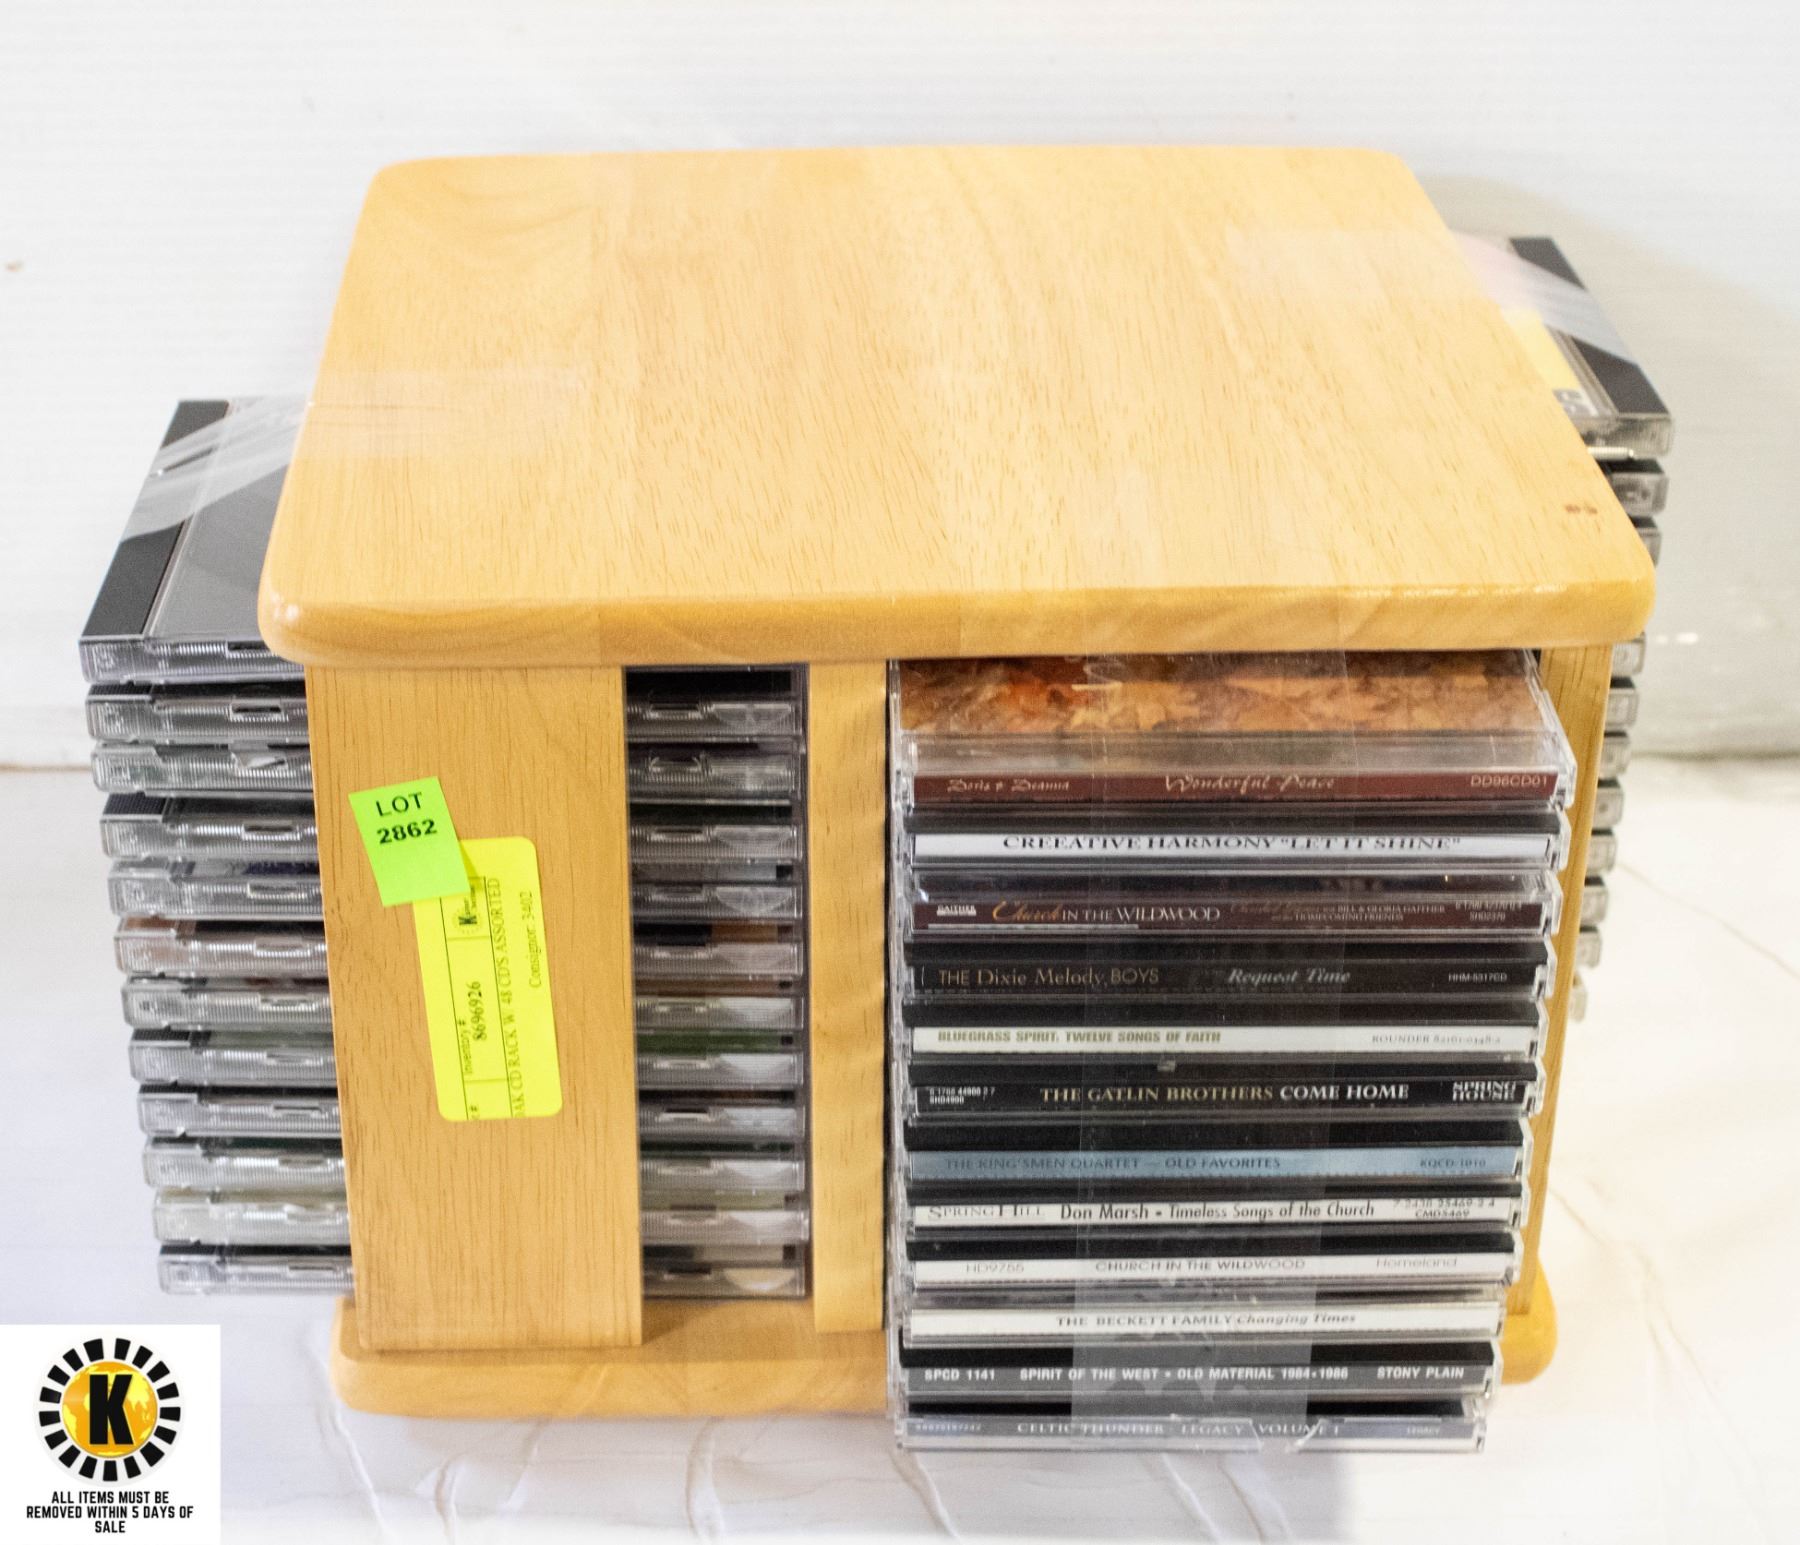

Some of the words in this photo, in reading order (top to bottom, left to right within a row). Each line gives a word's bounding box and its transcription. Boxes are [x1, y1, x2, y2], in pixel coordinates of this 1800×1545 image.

[1165, 774, 1270, 795] Wonderful
[1277, 774, 1335, 792] Peace
[375, 791, 423, 818] LOT
[376, 818, 439, 845] 2862
[1148, 836, 1275, 849] HARMONY
[1281, 835, 1341, 849] "LET
[1344, 836, 1363, 849] IT
[1374, 835, 1461, 849] SHINE"
[487, 878, 508, 955] ASSORTED
[1062, 905, 1075, 922] IN
[1083, 905, 1112, 922] THE
[1116, 905, 1221, 922] WILDWOOD
[938, 969, 970, 985] THE
[976, 968, 1027, 986] Dixie
[1034, 967, 1102, 988] Melody
[1110, 968, 1159, 985] BOYS
[1228, 968, 1298, 987] Request
[1305, 967, 1351, 982] Time
[467, 980, 488, 1042] 8696926
[937, 1030, 1011, 1043] BLUEGRASS
[1065, 1031, 1113, 1043] TWELVE
[1117, 1031, 1161, 1043] SONGS
[1165, 1031, 1181, 1043] OF
[1185, 1031, 1221, 1043] FAITH
[462, 1023, 473, 1076] Inventory
[505, 1028, 520, 1070] RACK
[509, 1070, 523, 1091] CD
[1453, 1081, 1517, 1091] SPRING
[1040, 1087, 1081, 1103] THE
[1087, 1087, 1160, 1102] GATLIN
[1166, 1085, 1274, 1102] BROTHERS
[1280, 1085, 1340, 1101] COME
[1346, 1084, 1409, 1100] HOME
[945, 1158, 972, 1169] THE
[1070, 1157, 1139, 1170] QUARTET
[1164, 1157, 1196, 1169] OLD
[1201, 1157, 1281, 1169] FAVORITES
[1060, 1206, 1092, 1220] Don
[1099, 1204, 1149, 1220] Marsh
[1169, 1203, 1228, 1219] Timeless
[1233, 1202, 1274, 1221] Songs
[1279, 1201, 1295, 1217] of
[1299, 1201, 1321, 1217] the
[1327, 1200, 1375, 1217] Church
[1095, 1261, 1161, 1272] CHURCH
[1165, 1260, 1182, 1271] IN
[1186, 1260, 1211, 1271] THE
[1216, 1258, 1306, 1270] WILDWOOD
[1376, 1257, 1457, 1268] Homeland
[1057, 1315, 1088, 1326] THE
[1096, 1315, 1167, 1326] BECKETT
[1172, 1315, 1233, 1325] FAMILY
[1237, 1313, 1307, 1326] Changing
[1313, 1312, 1356, 1324] Times
[924, 1368, 960, 1381] SPCD
[966, 1368, 996, 1381] 1141
[1020, 1368, 1062, 1381] SPIRIT
[1068, 1368, 1088, 1381] OF
[1092, 1368, 1117, 1381] THE
[1122, 1368, 1158, 1381] WEST
[1177, 1368, 1203, 1380] OLD
[1208, 1367, 1274, 1380] MATERIAL
[1377, 1366, 1420, 1379] STONY
[1426, 1366, 1464, 1379] PLAIN
[1017, 1422, 1072, 1434] CELTIC
[1080, 1422, 1164, 1434] THUNDER
[1181, 1423, 1244, 1435] LEGACY
